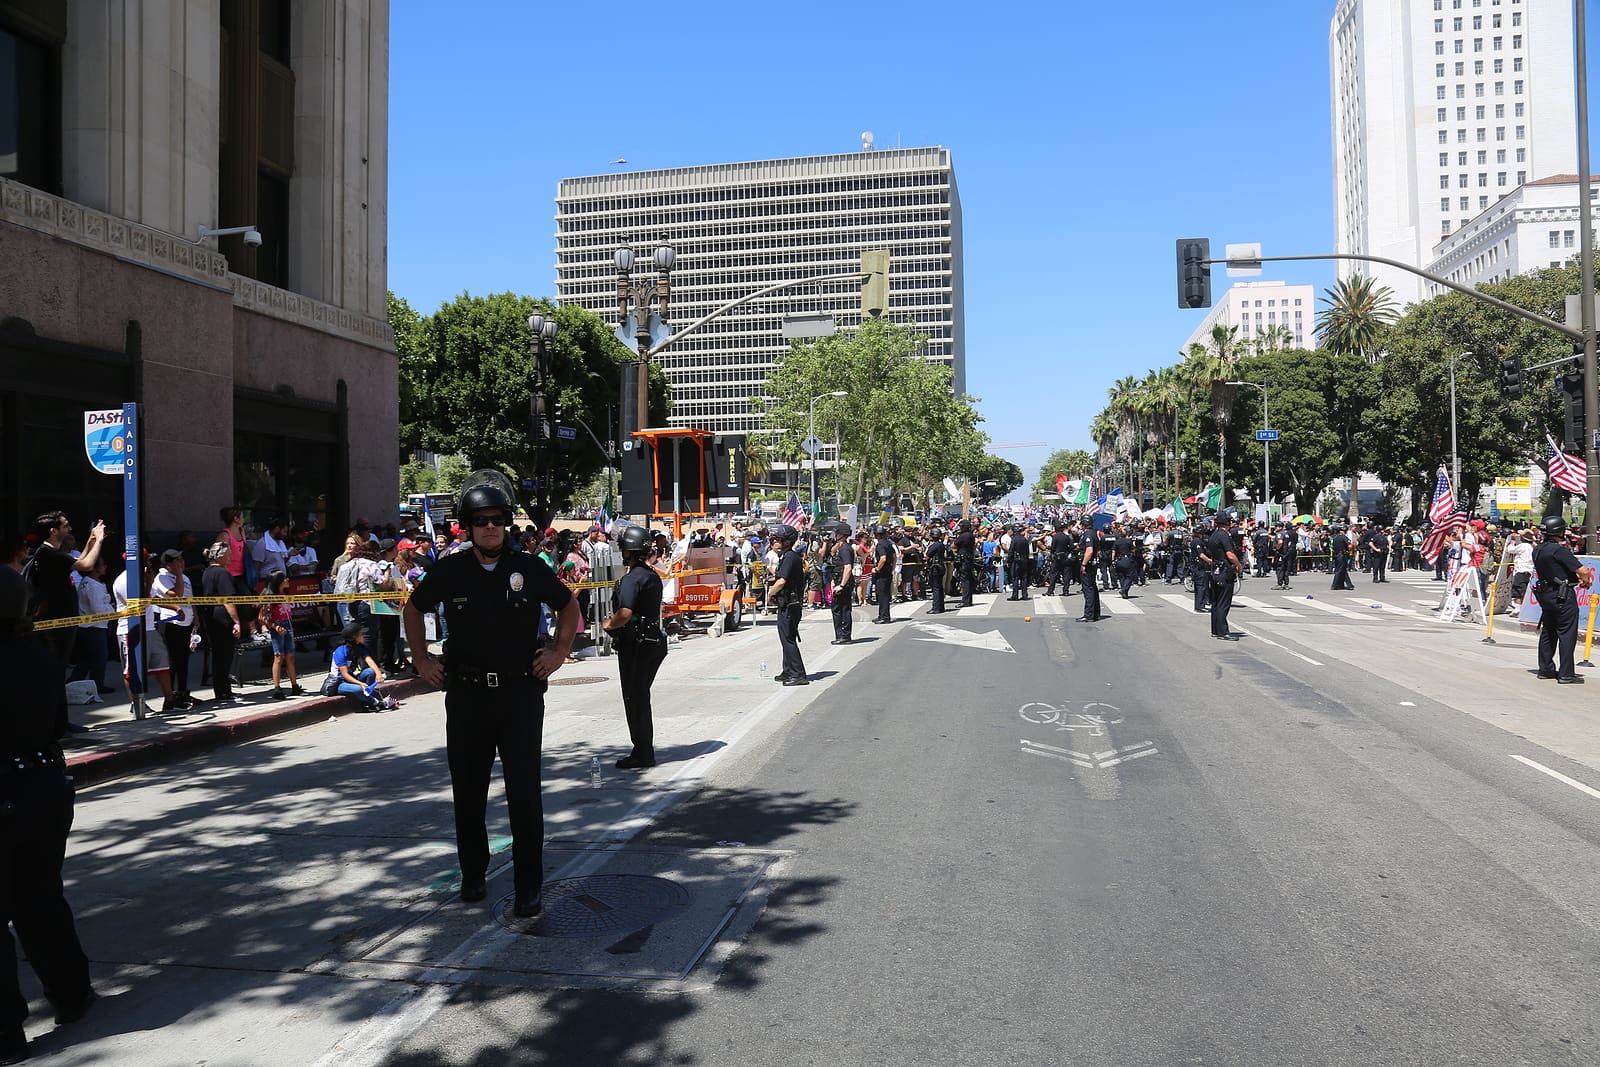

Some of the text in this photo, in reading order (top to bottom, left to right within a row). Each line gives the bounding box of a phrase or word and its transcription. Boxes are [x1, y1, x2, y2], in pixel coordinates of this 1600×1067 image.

[88, 412, 124, 425] DASH
[116, 440, 122, 449] D
[126, 416, 134, 480] LADOT
[727, 447, 736, 484] WANCO
